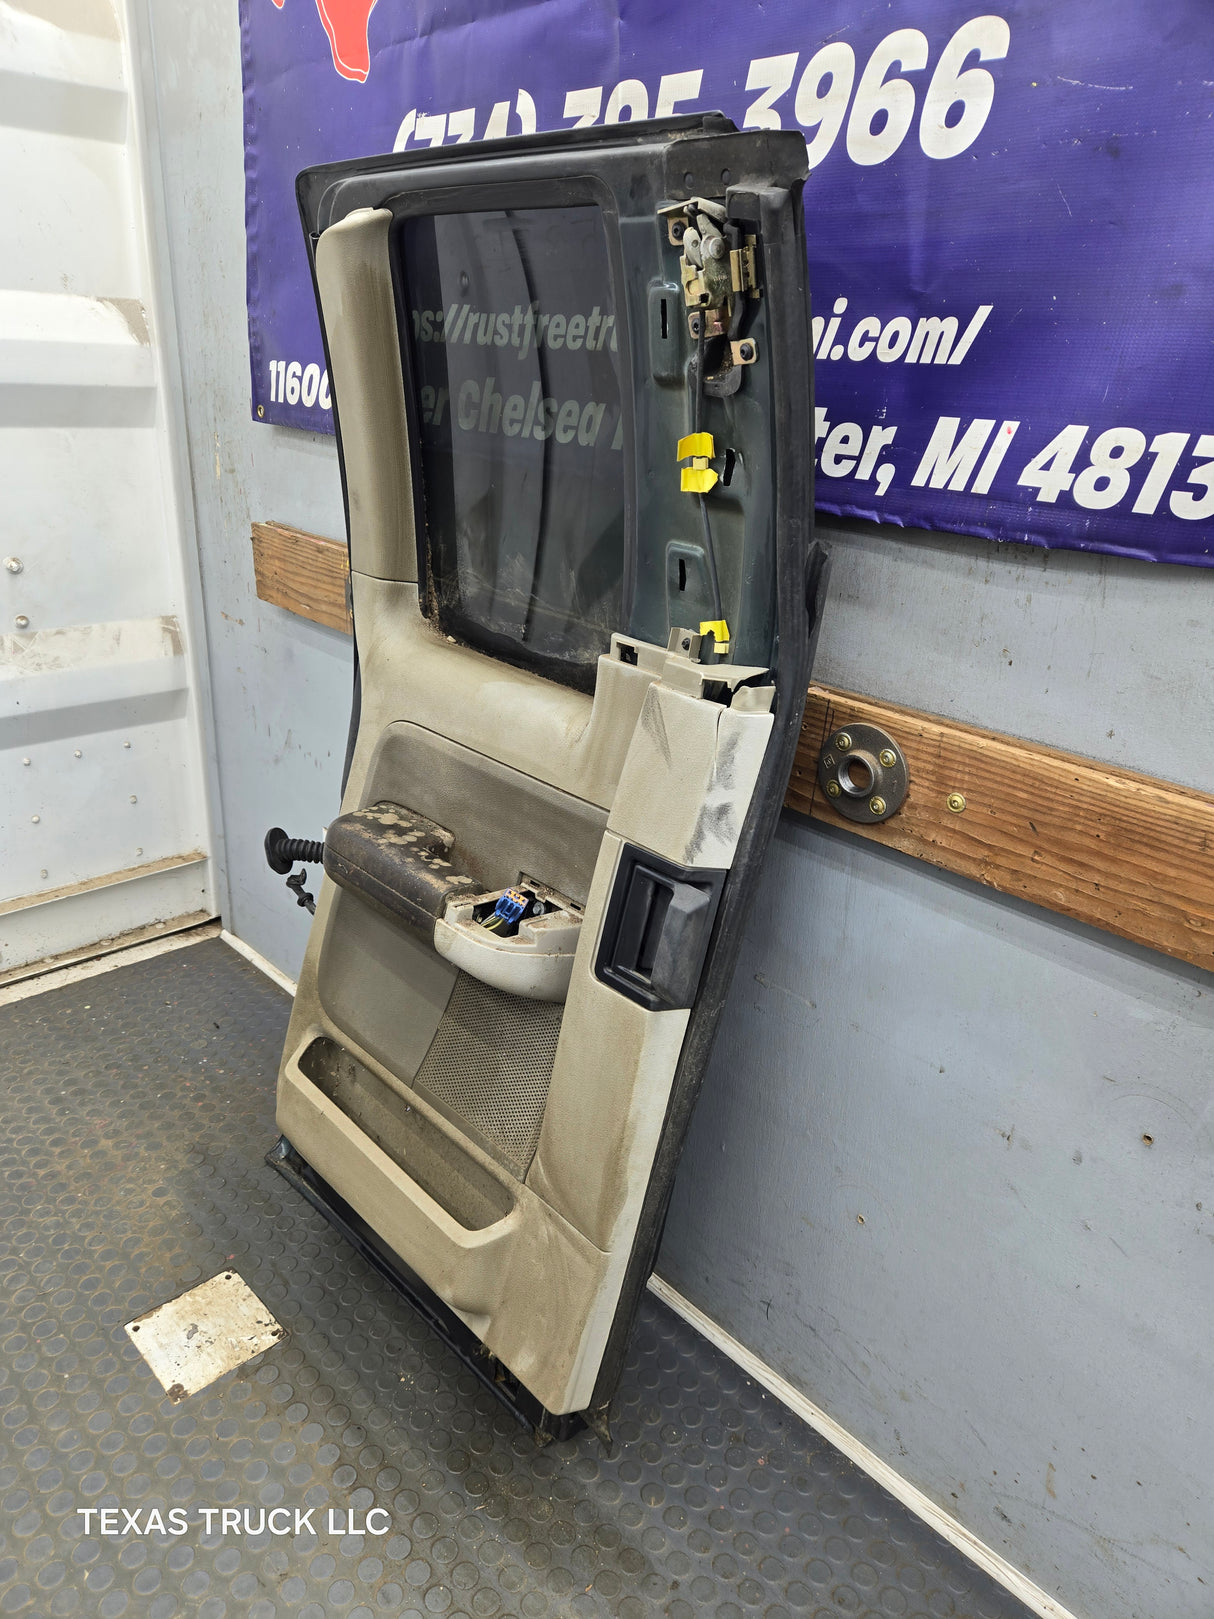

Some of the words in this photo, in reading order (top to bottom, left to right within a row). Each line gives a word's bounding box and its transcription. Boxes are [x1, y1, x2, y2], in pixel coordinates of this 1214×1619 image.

[743, 16, 1010, 170] 3966
[457, 377, 607, 447] Chelsea
[911, 417, 1020, 494] MI
